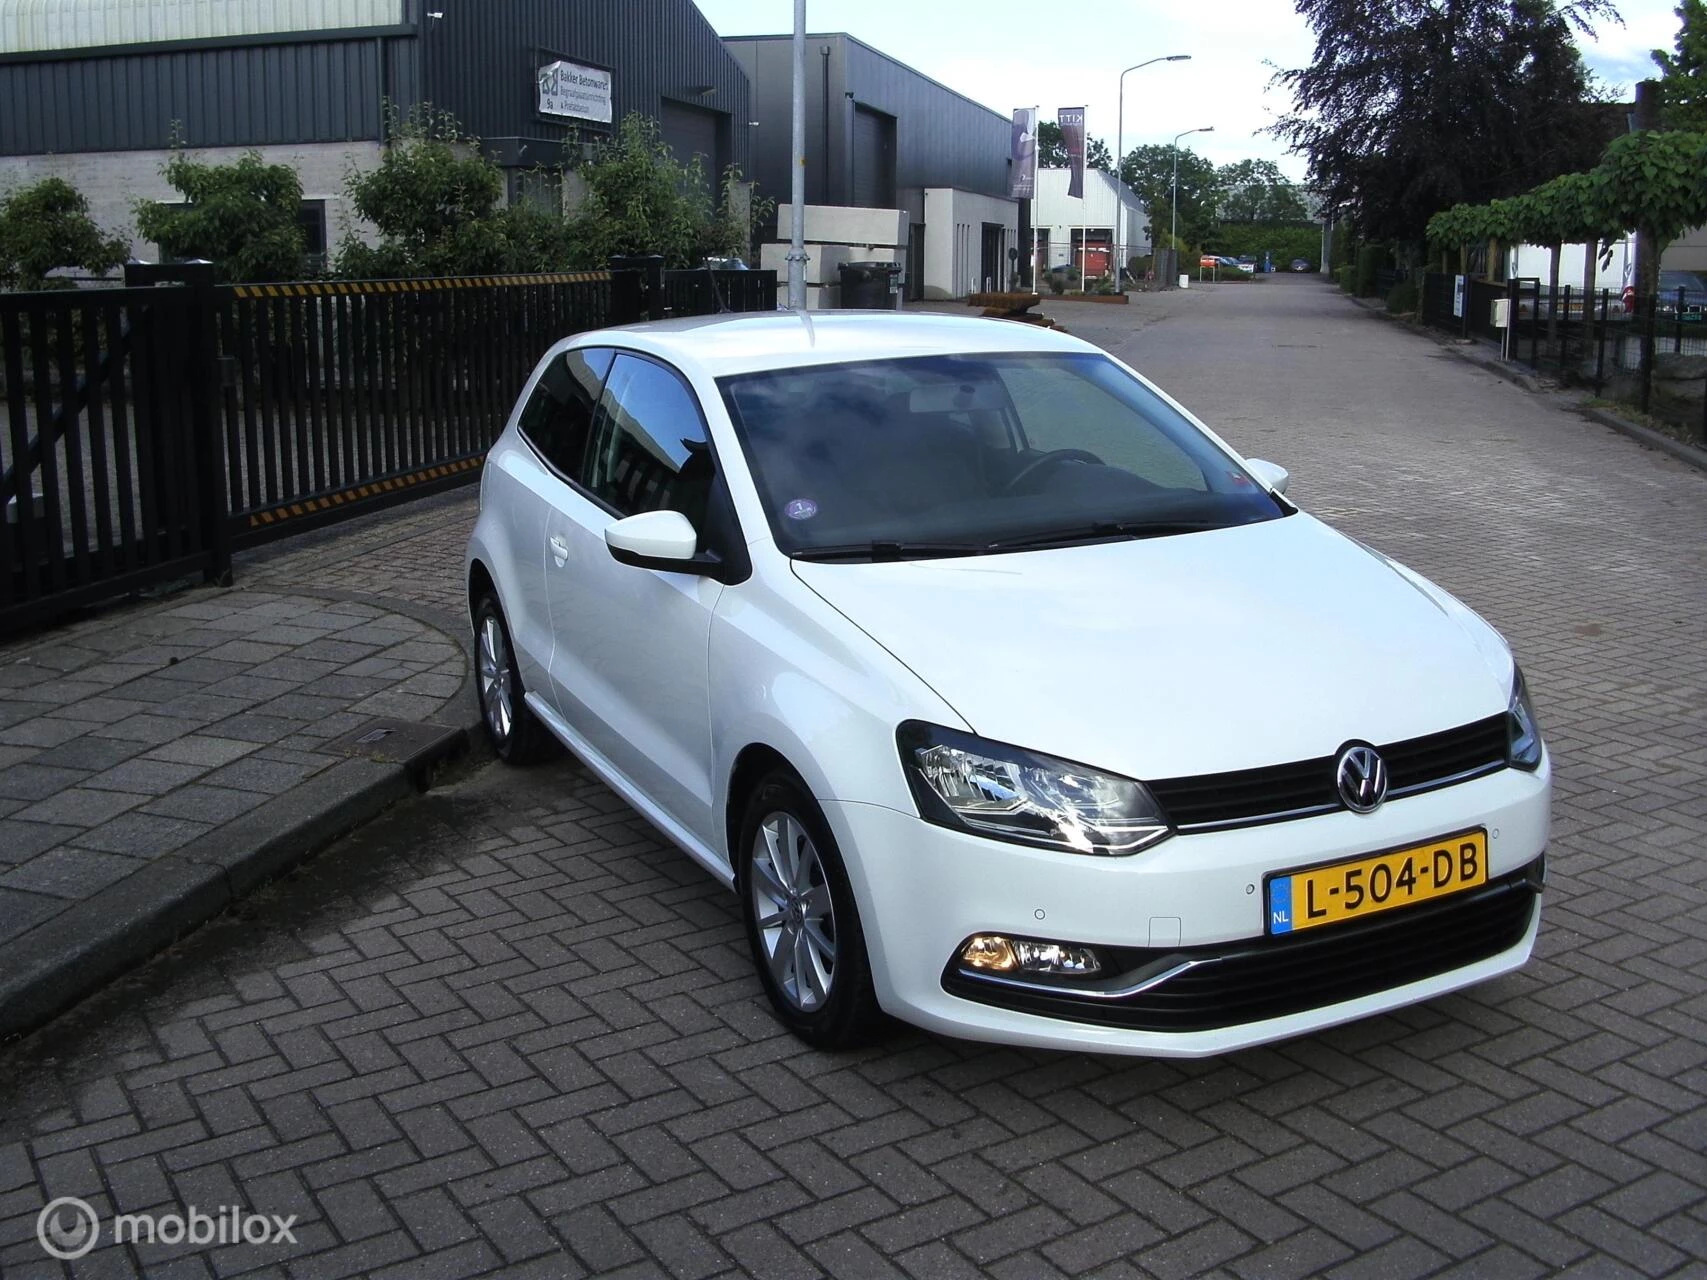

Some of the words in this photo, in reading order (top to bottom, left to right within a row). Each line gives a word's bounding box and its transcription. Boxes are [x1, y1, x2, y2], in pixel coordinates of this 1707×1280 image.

[560, 69, 578, 85] Bakker
[1306, 842, 1478, 919] L-504-DB
[1273, 912, 1289, 924] NL
